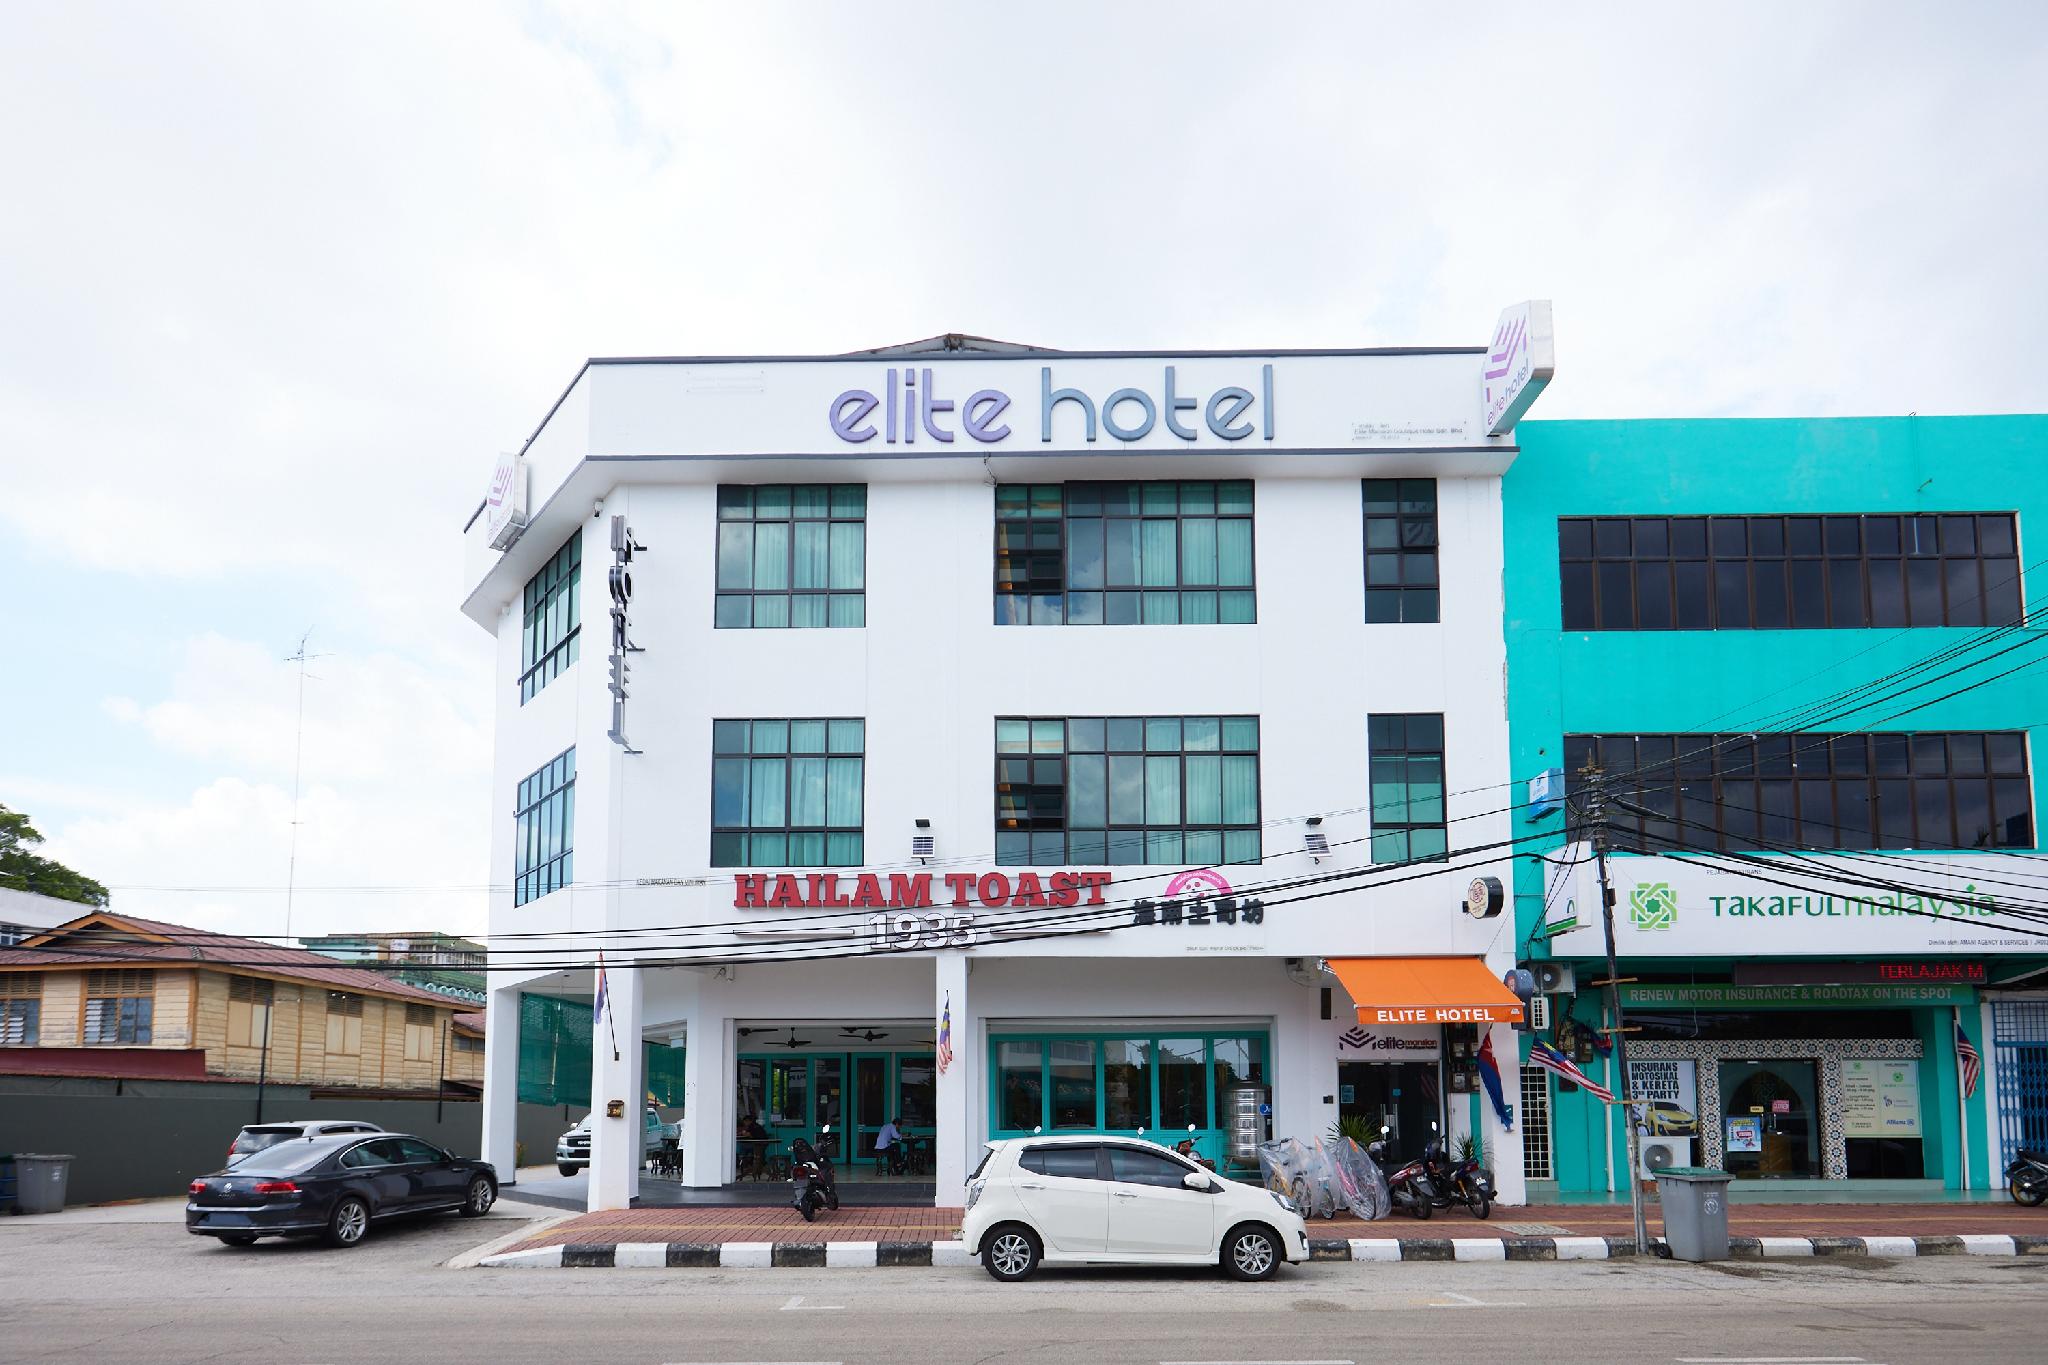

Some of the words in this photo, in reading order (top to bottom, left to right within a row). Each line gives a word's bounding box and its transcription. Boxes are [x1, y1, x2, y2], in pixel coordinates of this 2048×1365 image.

[829, 367, 1011, 444] elite
[1041, 364, 1273, 442] hotel
[733, 874, 932, 908] HAILAM
[945, 872, 1112, 907] TOAST
[869, 912, 977, 949] 1935
[1880, 964, 1963, 979] TERLAJAK
[1631, 990, 1674, 1001] RENEW
[1679, 989, 1722, 1001] MOTOR
[1726, 988, 1797, 1000] INSURANCE
[1801, 988, 1808, 1000] &
[1814, 987, 1869, 999] ROADTAX
[1873, 987, 1890, 999] ON
[1895, 987, 1917, 999] THE
[1920, 987, 1952, 999] SPOT
[1377, 1010, 1427, 1022] ELITE
[1435, 1008, 1494, 1021] HOTEL
[1377, 1036, 1405, 1050] elite
[1631, 1062, 1678, 1072] INSURANS
[1632, 1072, 1679, 1080] MOTOSIKAL
[1632, 1081, 1639, 1090] &
[1642, 1081, 1679, 1090] KERETA
[1647, 1091, 1680, 1099] PARTY
